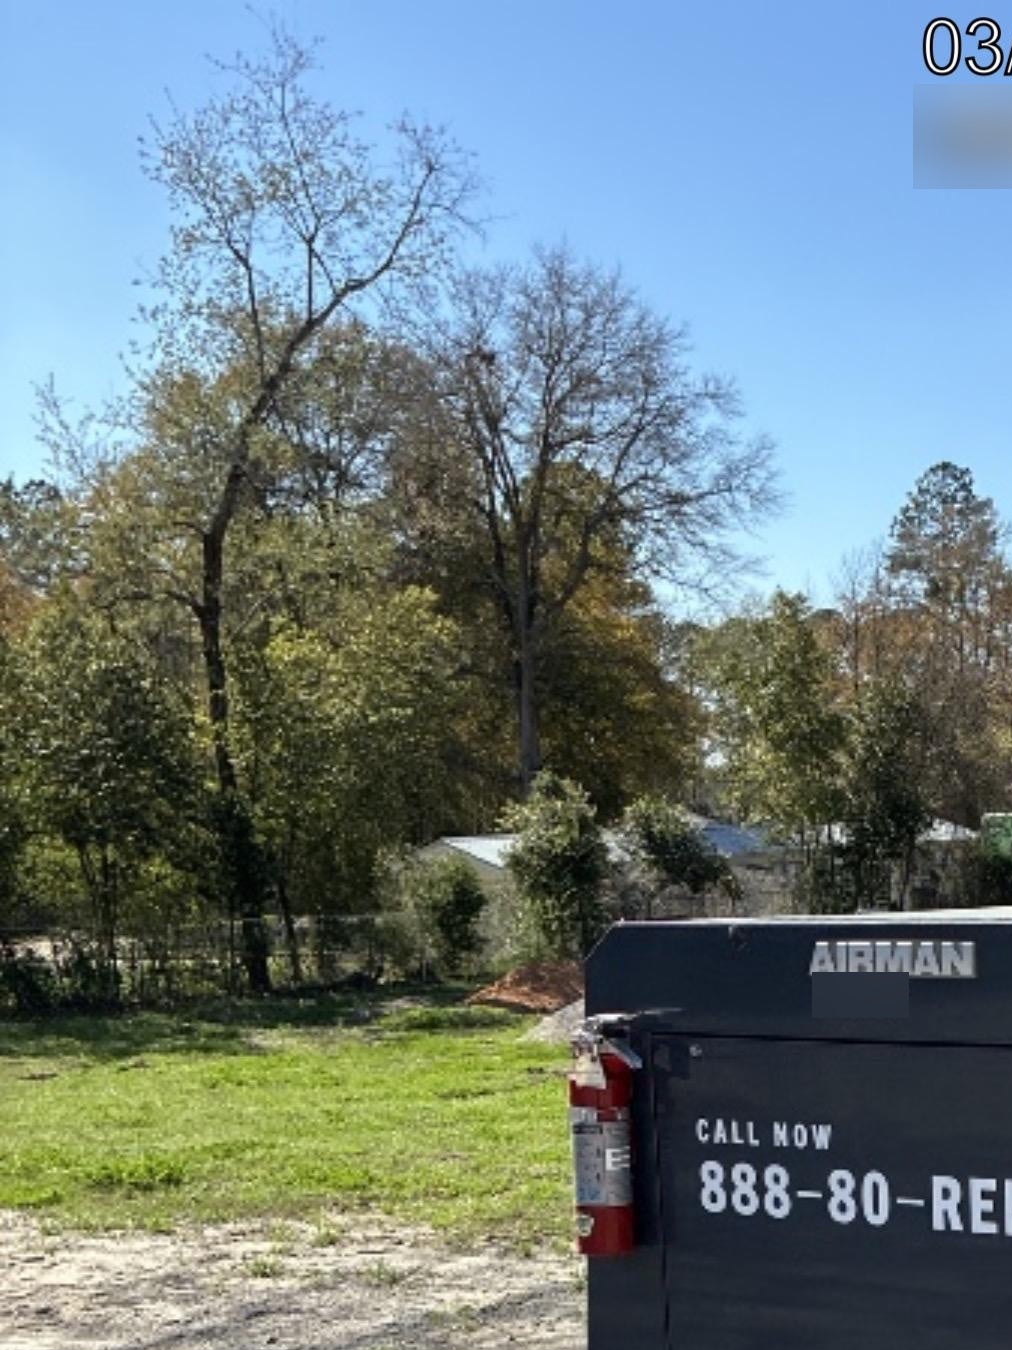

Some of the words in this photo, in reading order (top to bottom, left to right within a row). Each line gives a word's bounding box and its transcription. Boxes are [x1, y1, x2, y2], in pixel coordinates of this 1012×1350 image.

[809, 941, 976, 978] AIRMAN
[695, 1118, 760, 1147] CALL
[772, 1121, 833, 1150] NOW
